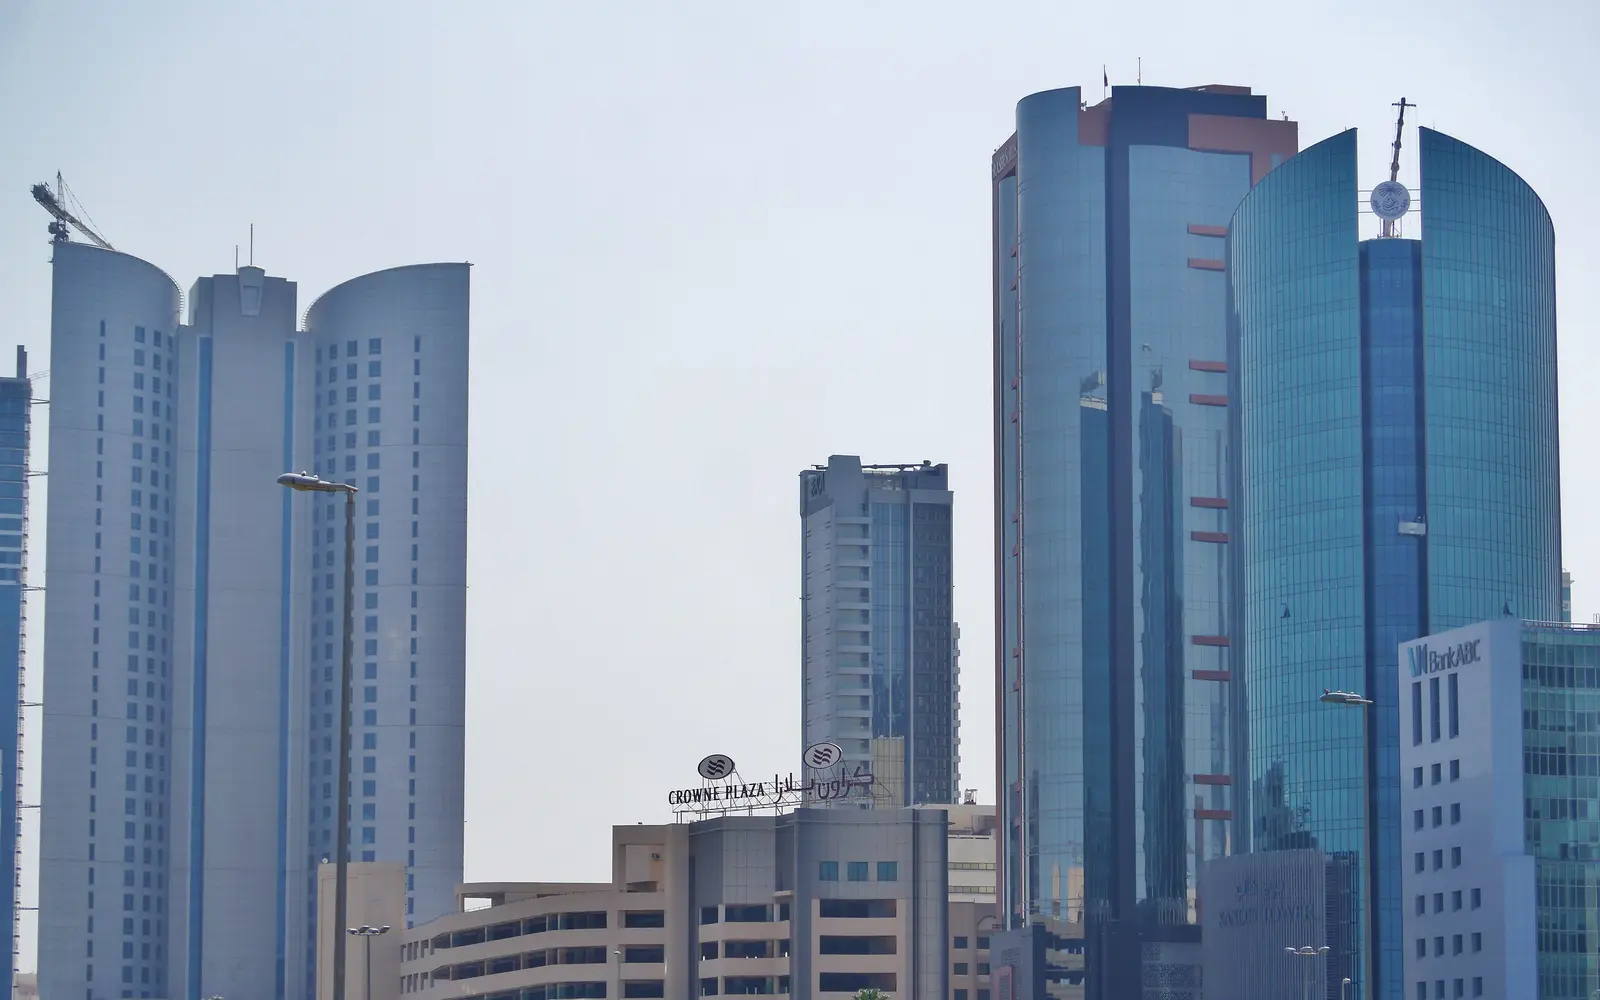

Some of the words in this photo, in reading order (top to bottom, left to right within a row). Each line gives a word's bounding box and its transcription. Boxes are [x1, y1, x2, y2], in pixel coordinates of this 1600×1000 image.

[668, 786, 720, 805] CROWNE
[725, 782, 765, 800] PLAZA
[774, 773, 813, 804] بلازا
[817, 766, 875, 800] كراون
